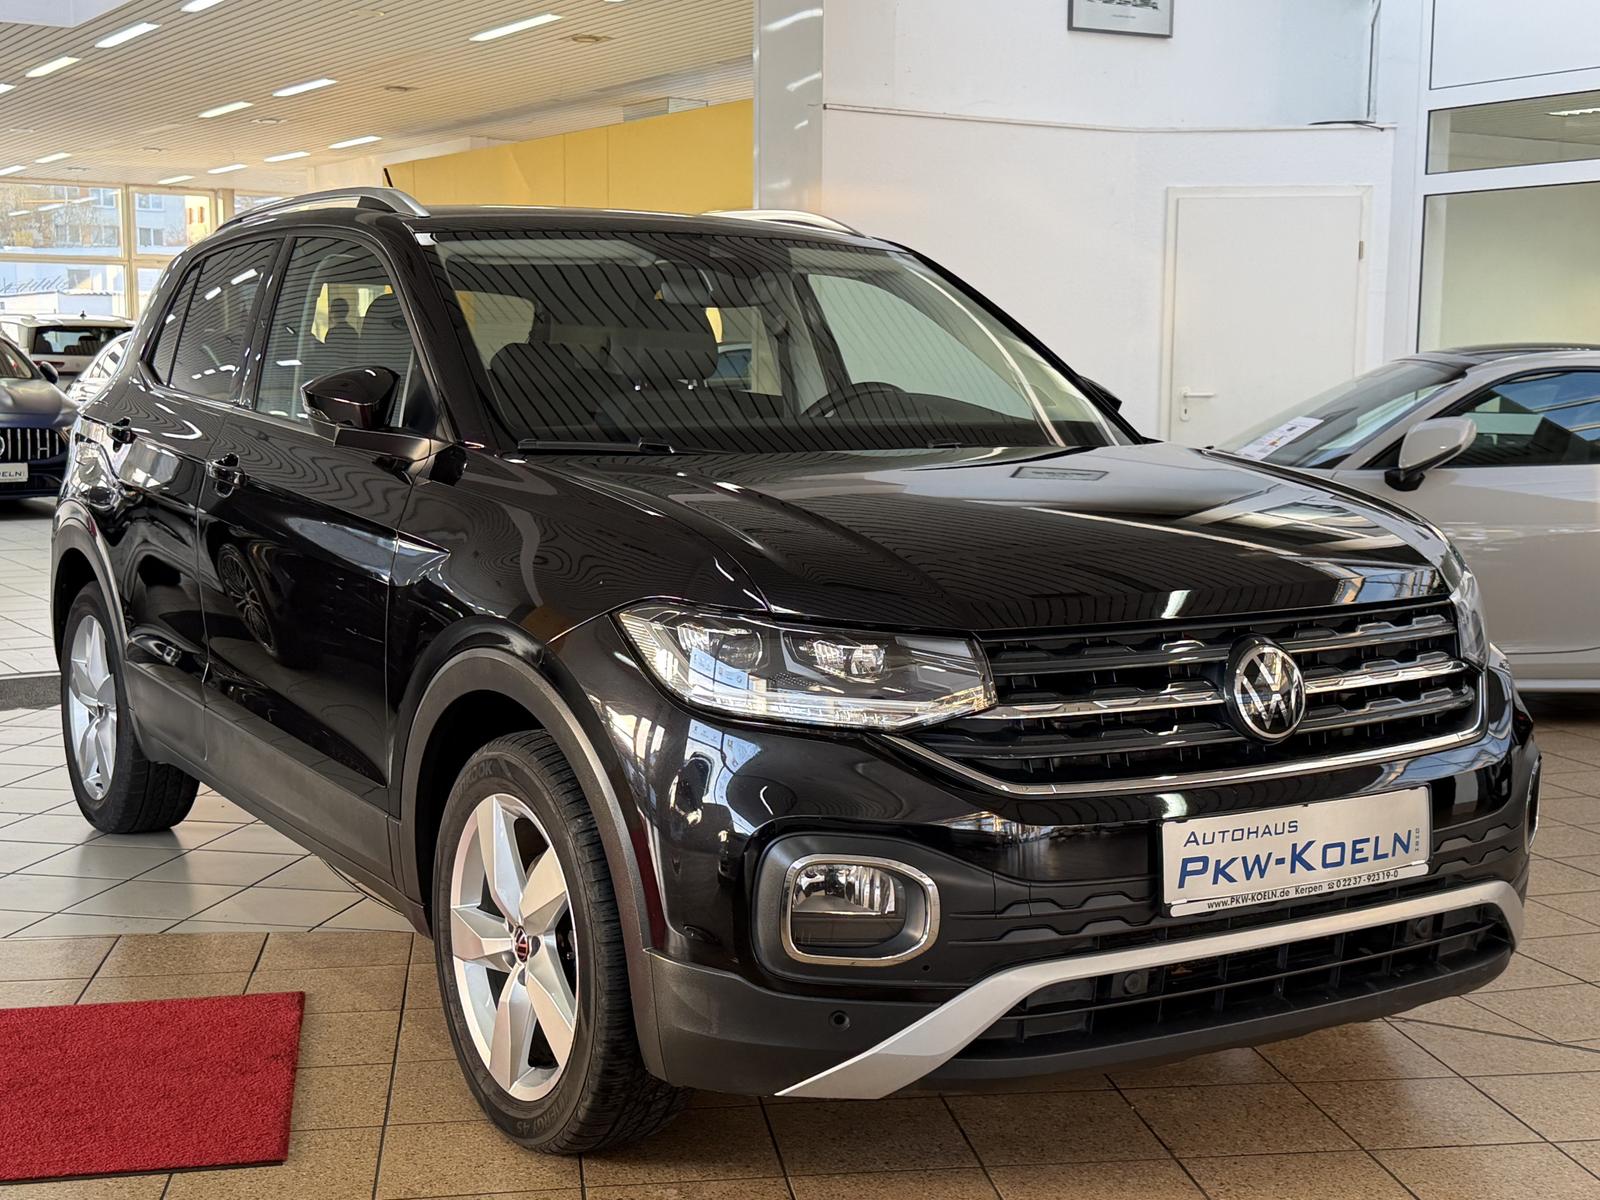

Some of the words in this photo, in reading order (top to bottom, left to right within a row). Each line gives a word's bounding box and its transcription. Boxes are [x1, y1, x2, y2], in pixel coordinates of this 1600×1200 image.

[1183, 820, 1299, 847] AUTOHAUS
[1177, 829, 1412, 889] PKW-KOELN
[1207, 889, 1290, 909] www.PKW-KOELN.de
[1294, 883, 1323, 895] Kerpen
